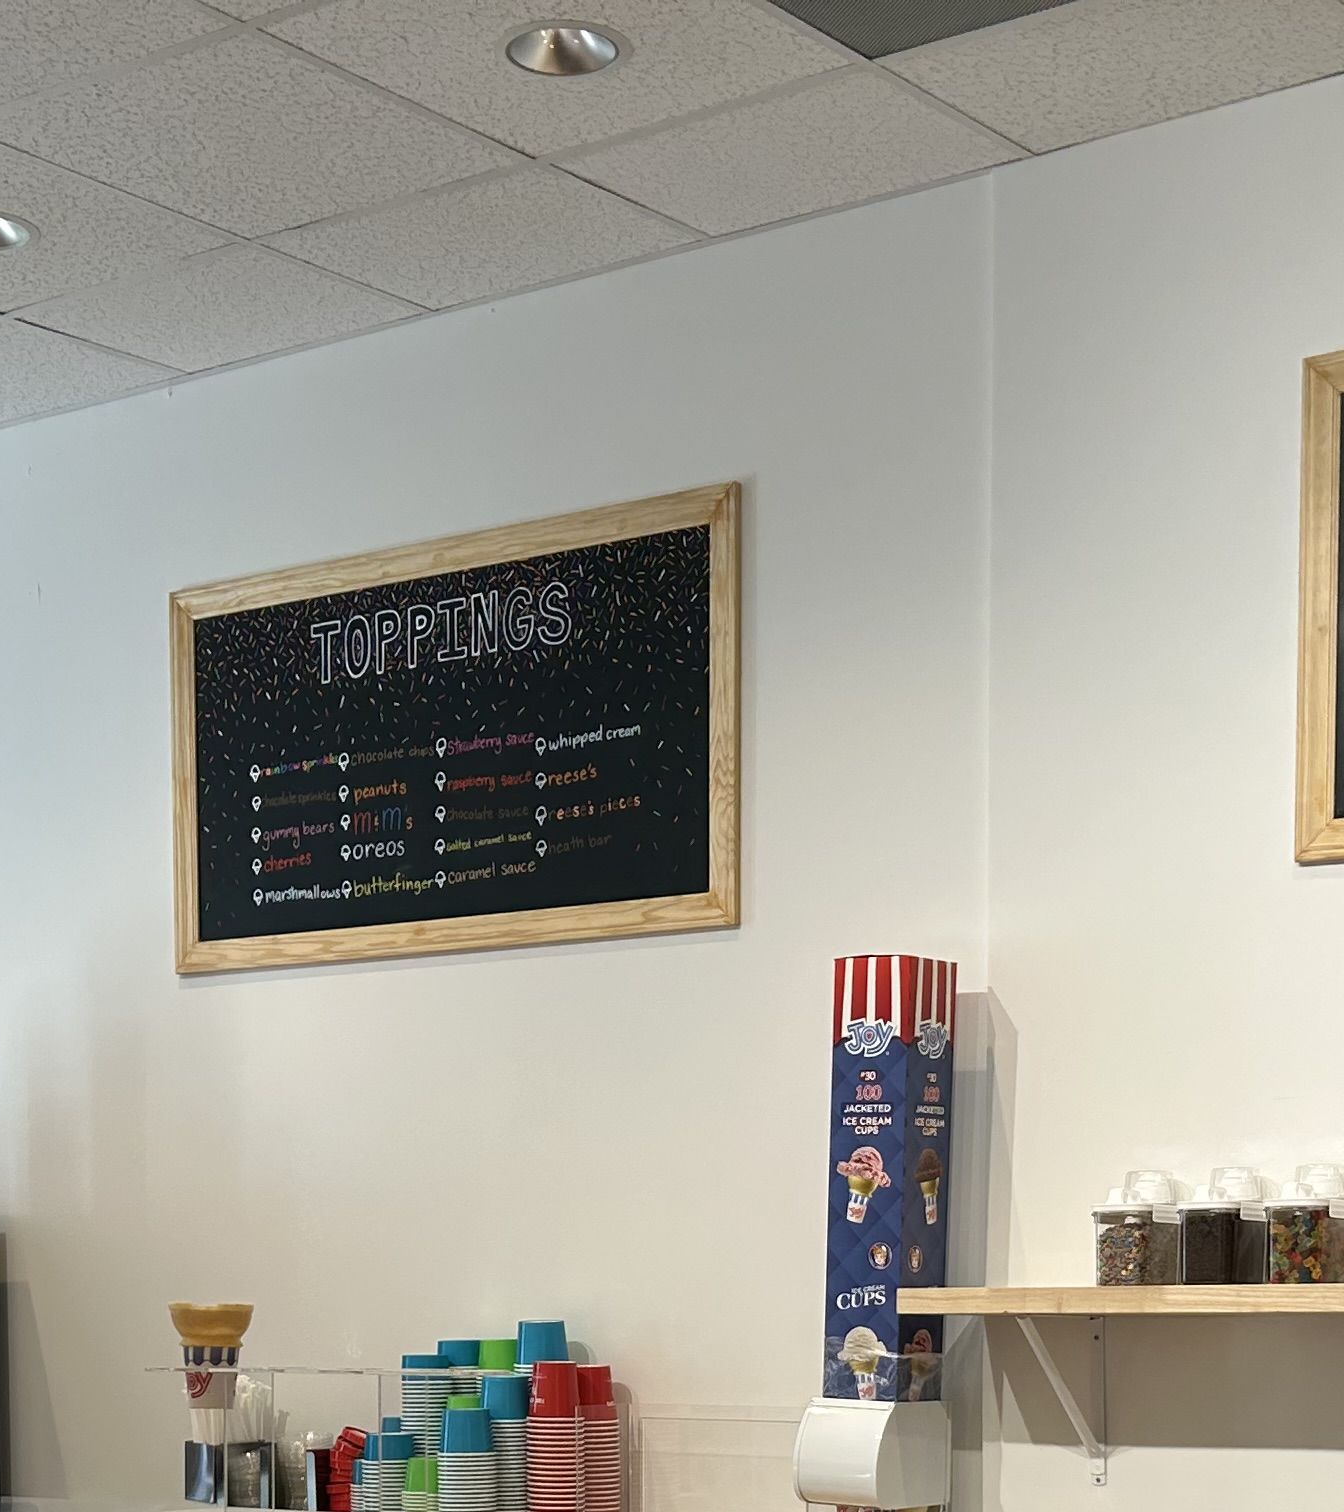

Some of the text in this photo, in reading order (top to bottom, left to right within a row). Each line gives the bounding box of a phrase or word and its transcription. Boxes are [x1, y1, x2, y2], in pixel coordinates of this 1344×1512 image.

[310, 581, 572, 685] TOPPINGS
[505, 731, 535, 746] sauce
[548, 723, 641, 750] whipped cream
[351, 748, 404, 767] chocolate
[260, 761, 301, 777] rainbow
[500, 770, 534, 786] sauce
[548, 763, 597, 786] reese's
[353, 779, 407, 804] peanuts
[446, 804, 530, 822] chocolate sauce
[548, 794, 641, 821] reese's pieces
[262, 820, 336, 851] gummy bears
[474, 834, 505, 847] caramel
[507, 830, 533, 842] sauce
[547, 833, 612, 855] heath bar
[353, 840, 405, 860] oreos
[263, 852, 312, 873] cherries
[448, 859, 536, 884] caramel sauce
[265, 884, 341, 903] marshmallows
[353, 872, 434, 898] butterfinger
[855, 1084, 883, 1101] 100
[844, 1104, 891, 1113] JACKETED
[842, 1117, 892, 1126] ICE CREAM
[854, 1126, 879, 1135] CUPS
[836, 1289, 887, 1310] CUPS
